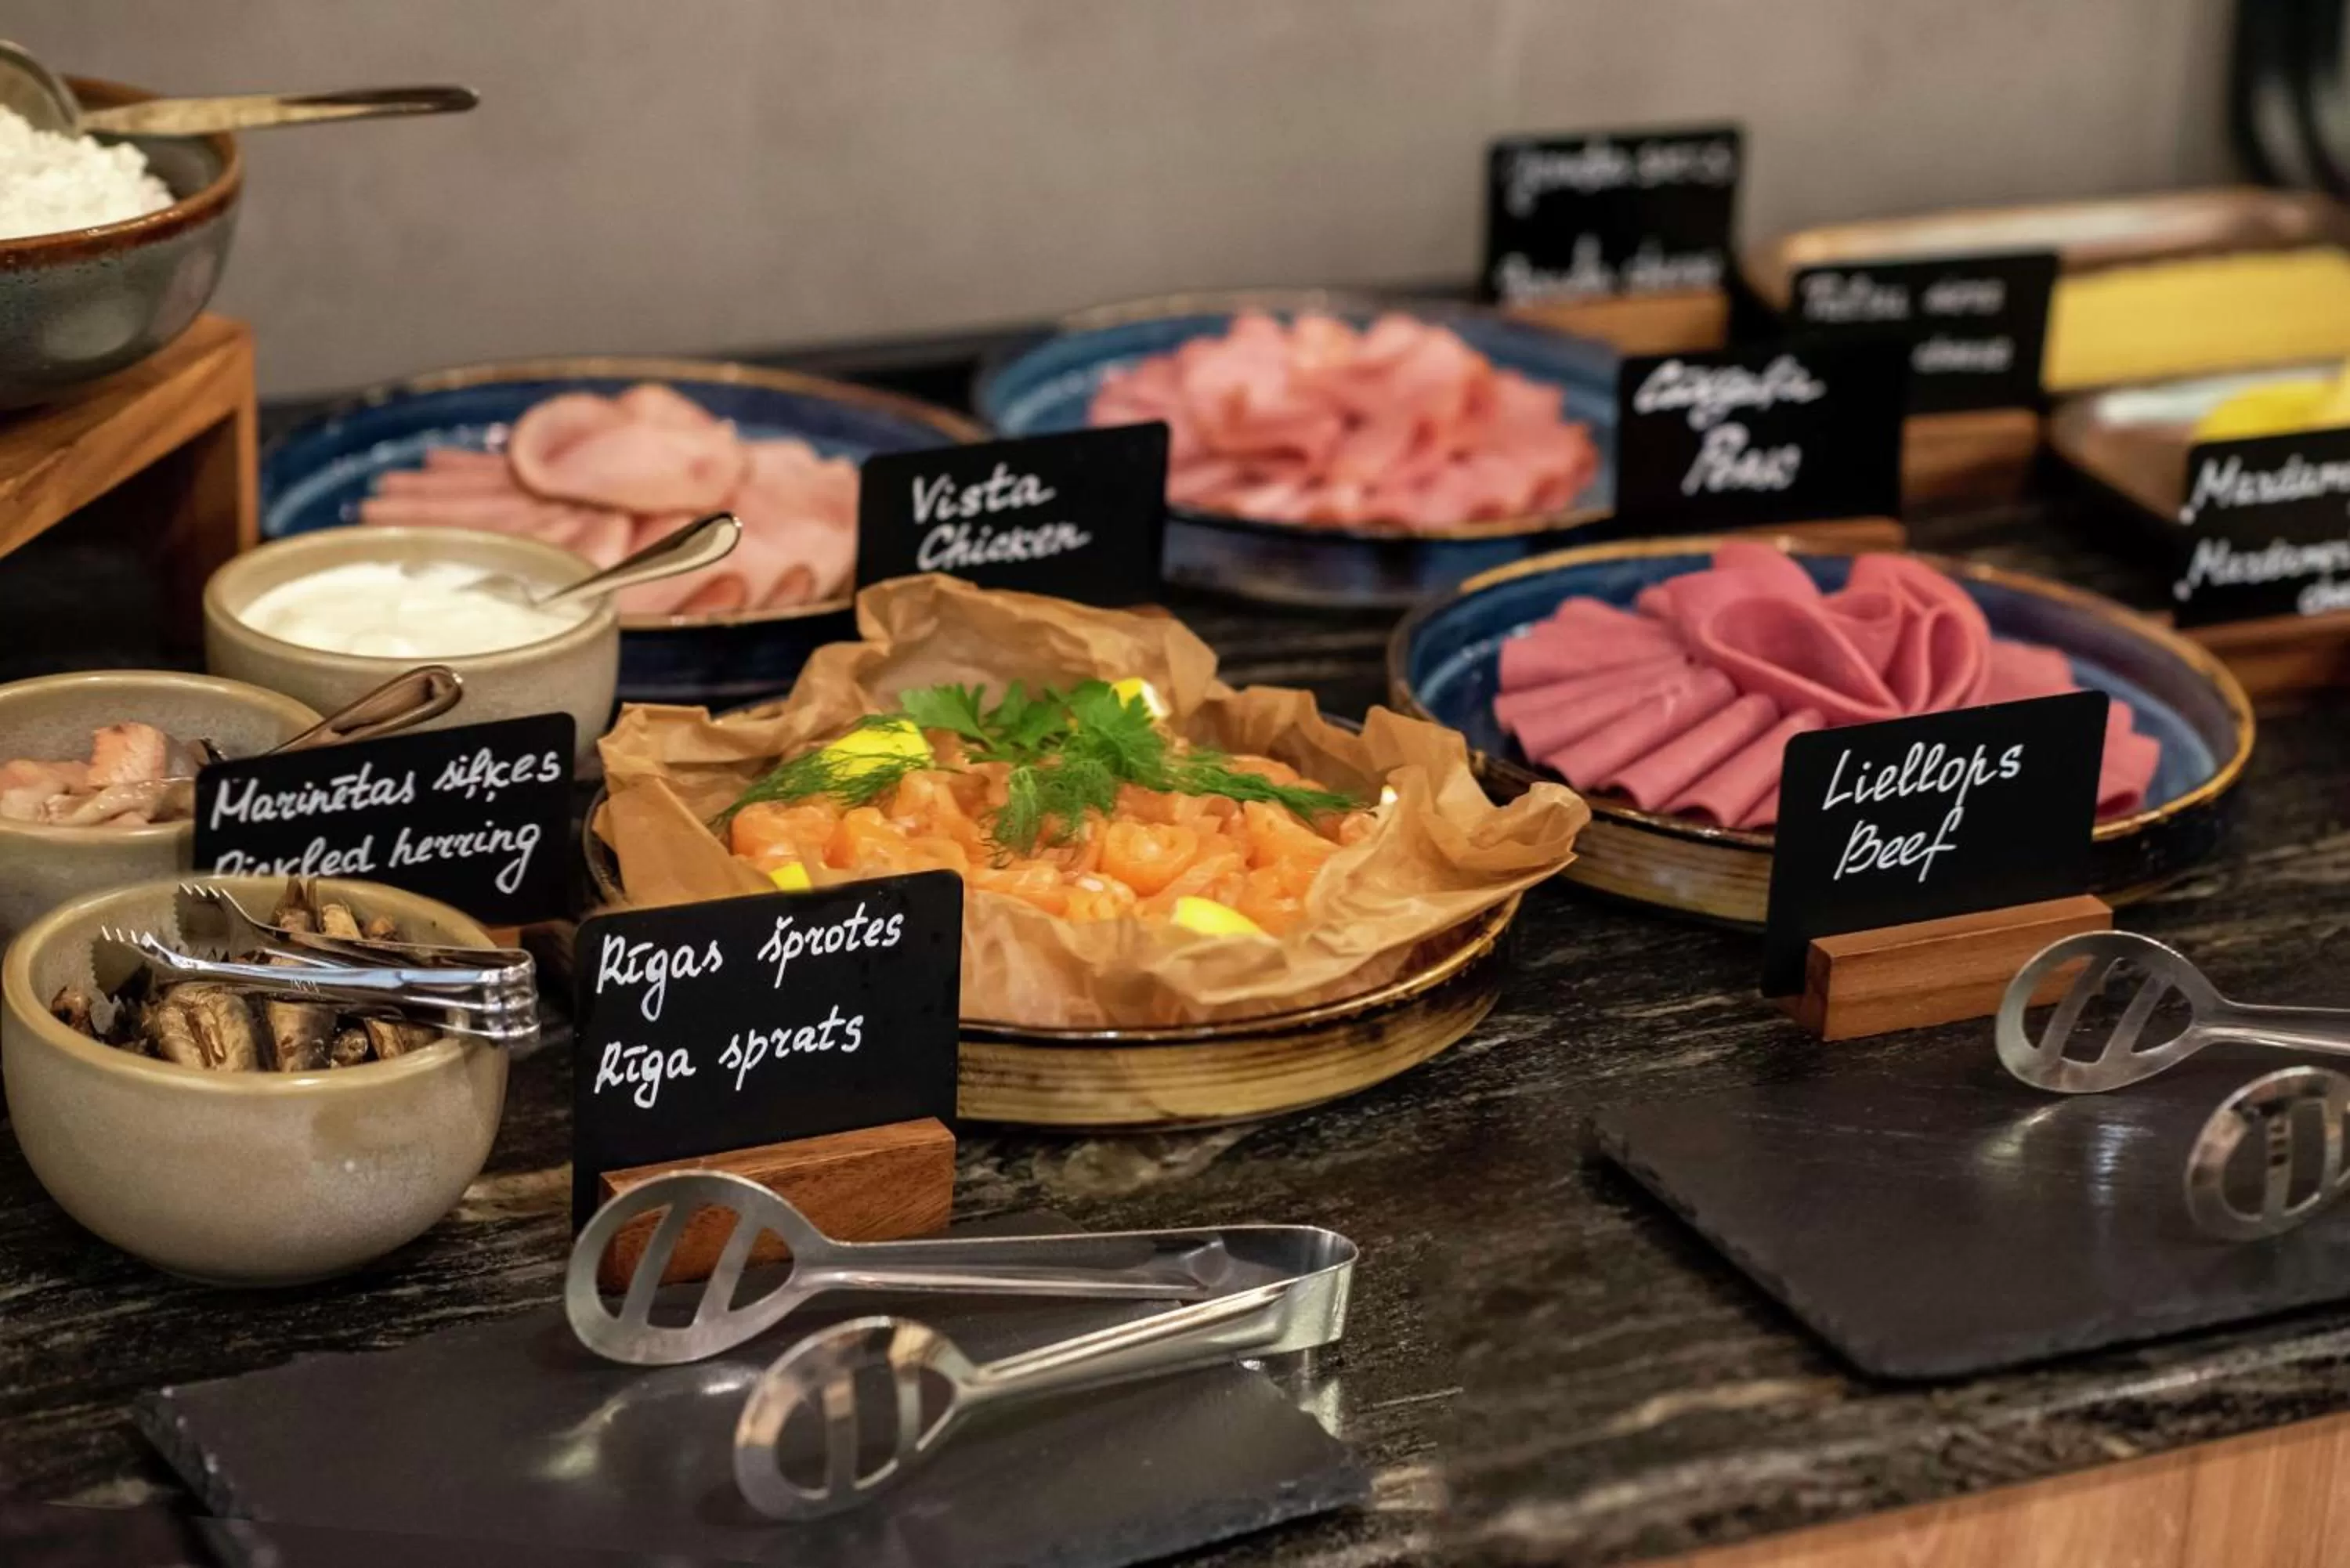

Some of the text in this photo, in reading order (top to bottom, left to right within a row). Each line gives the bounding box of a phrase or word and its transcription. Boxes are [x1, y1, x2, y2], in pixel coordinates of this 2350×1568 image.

[912, 462, 1056, 524] Vista
[916, 522, 1091, 572] Chicken
[210, 761, 416, 830] Marinētas
[1821, 741, 2024, 811] Liellops
[388, 819, 540, 894] herring
[1833, 805, 1965, 883] Beef
[595, 933, 724, 1021] Rīgas
[593, 1003, 865, 1110] Rīga sprats
